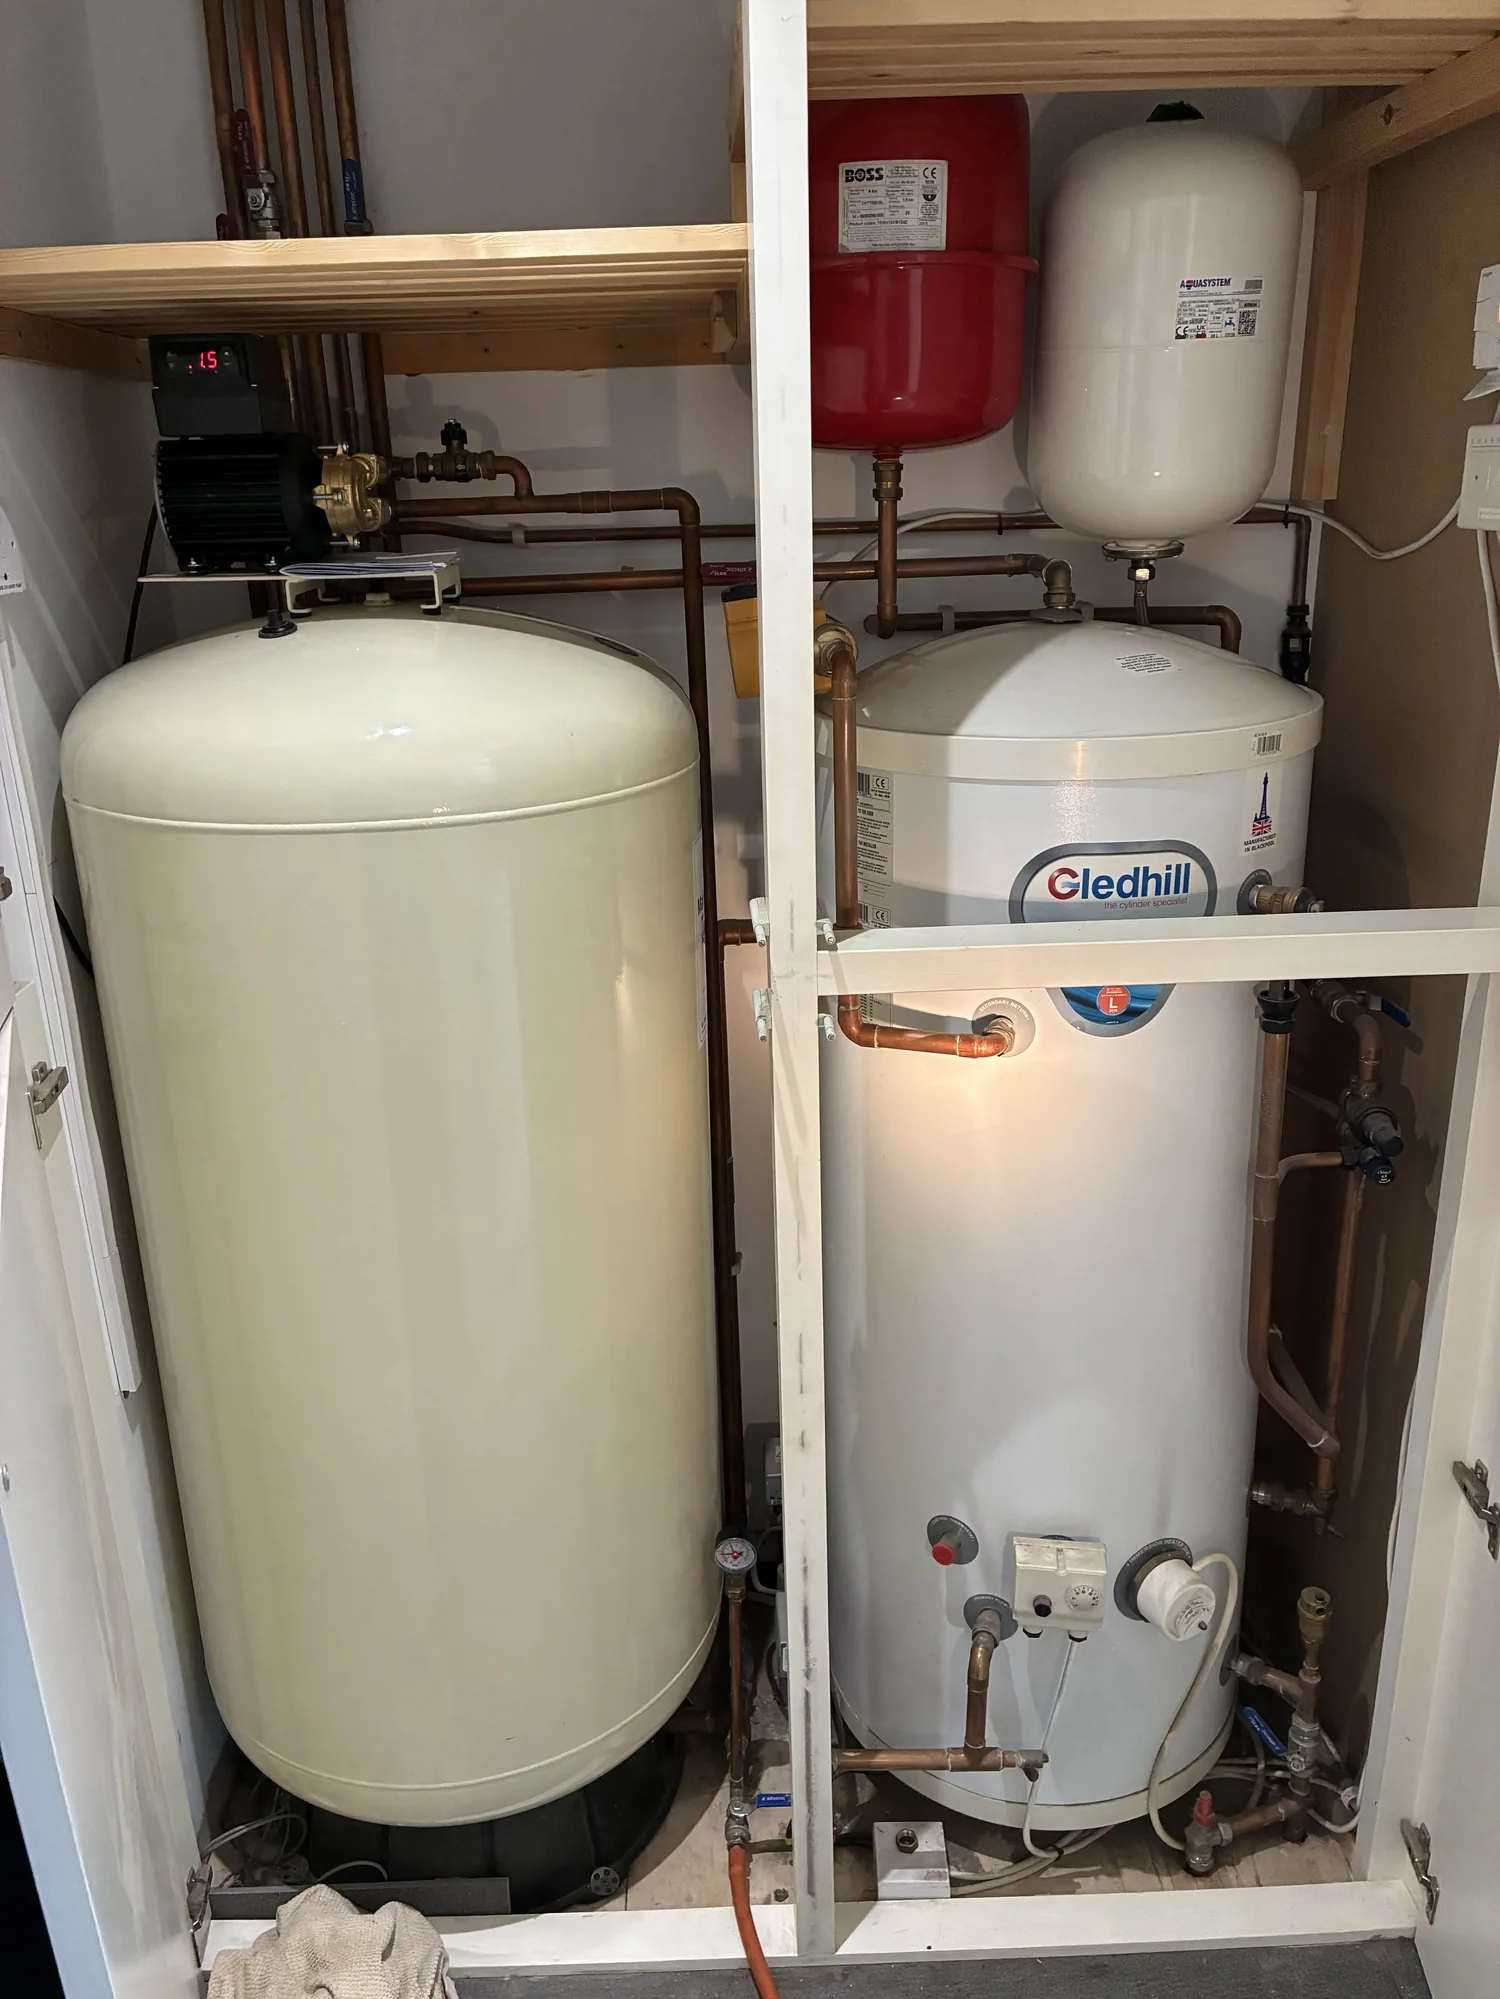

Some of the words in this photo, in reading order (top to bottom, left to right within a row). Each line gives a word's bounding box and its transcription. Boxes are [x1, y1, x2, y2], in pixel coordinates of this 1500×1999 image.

[845, 167, 884, 183] BOSS
[875, 777, 886, 788] CE
[1243, 833, 1277, 846] MANUFACTURED
[1244, 845, 1250, 853] IN
[1251, 840, 1275, 852] BLACKPOOL
[1047, 862, 1191, 901] Gledhill
[1104, 901, 1117, 909] the
[1119, 899, 1150, 911] cylinder
[1152, 896, 1188, 908] specialist
[875, 909, 885, 921] CE
[979, 1000, 1009, 1012] SECONDARY
[1010, 1002, 1029, 1019] RETURN
[1109, 997, 1118, 1008] L
[1129, 1540, 1163, 1564] IMMERSION
[1164, 1539, 1185, 1547] HEATER
